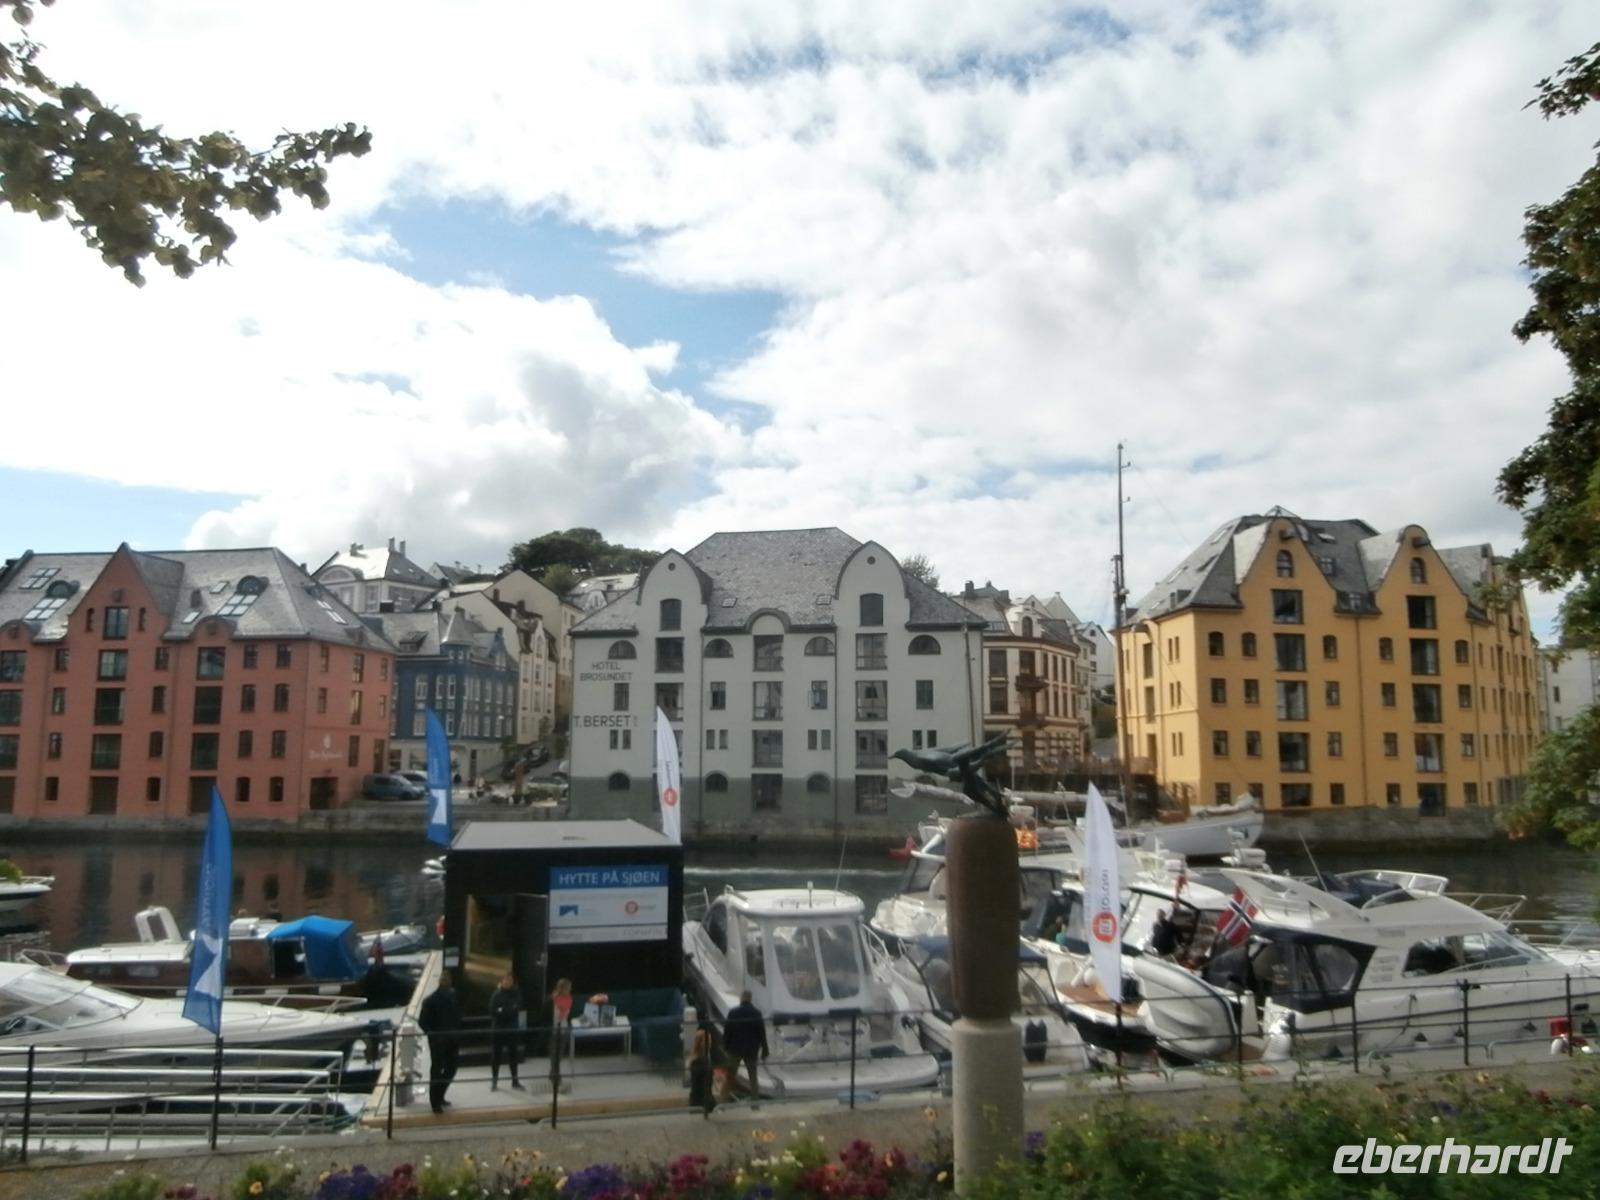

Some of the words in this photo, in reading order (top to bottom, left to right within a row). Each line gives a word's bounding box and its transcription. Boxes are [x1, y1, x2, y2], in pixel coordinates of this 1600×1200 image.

[592, 661, 621, 671] HOTEL
[559, 872, 599, 885] HYTTE
[602, 869, 621, 883] PÅ
[622, 871, 660, 885] SJØEN
